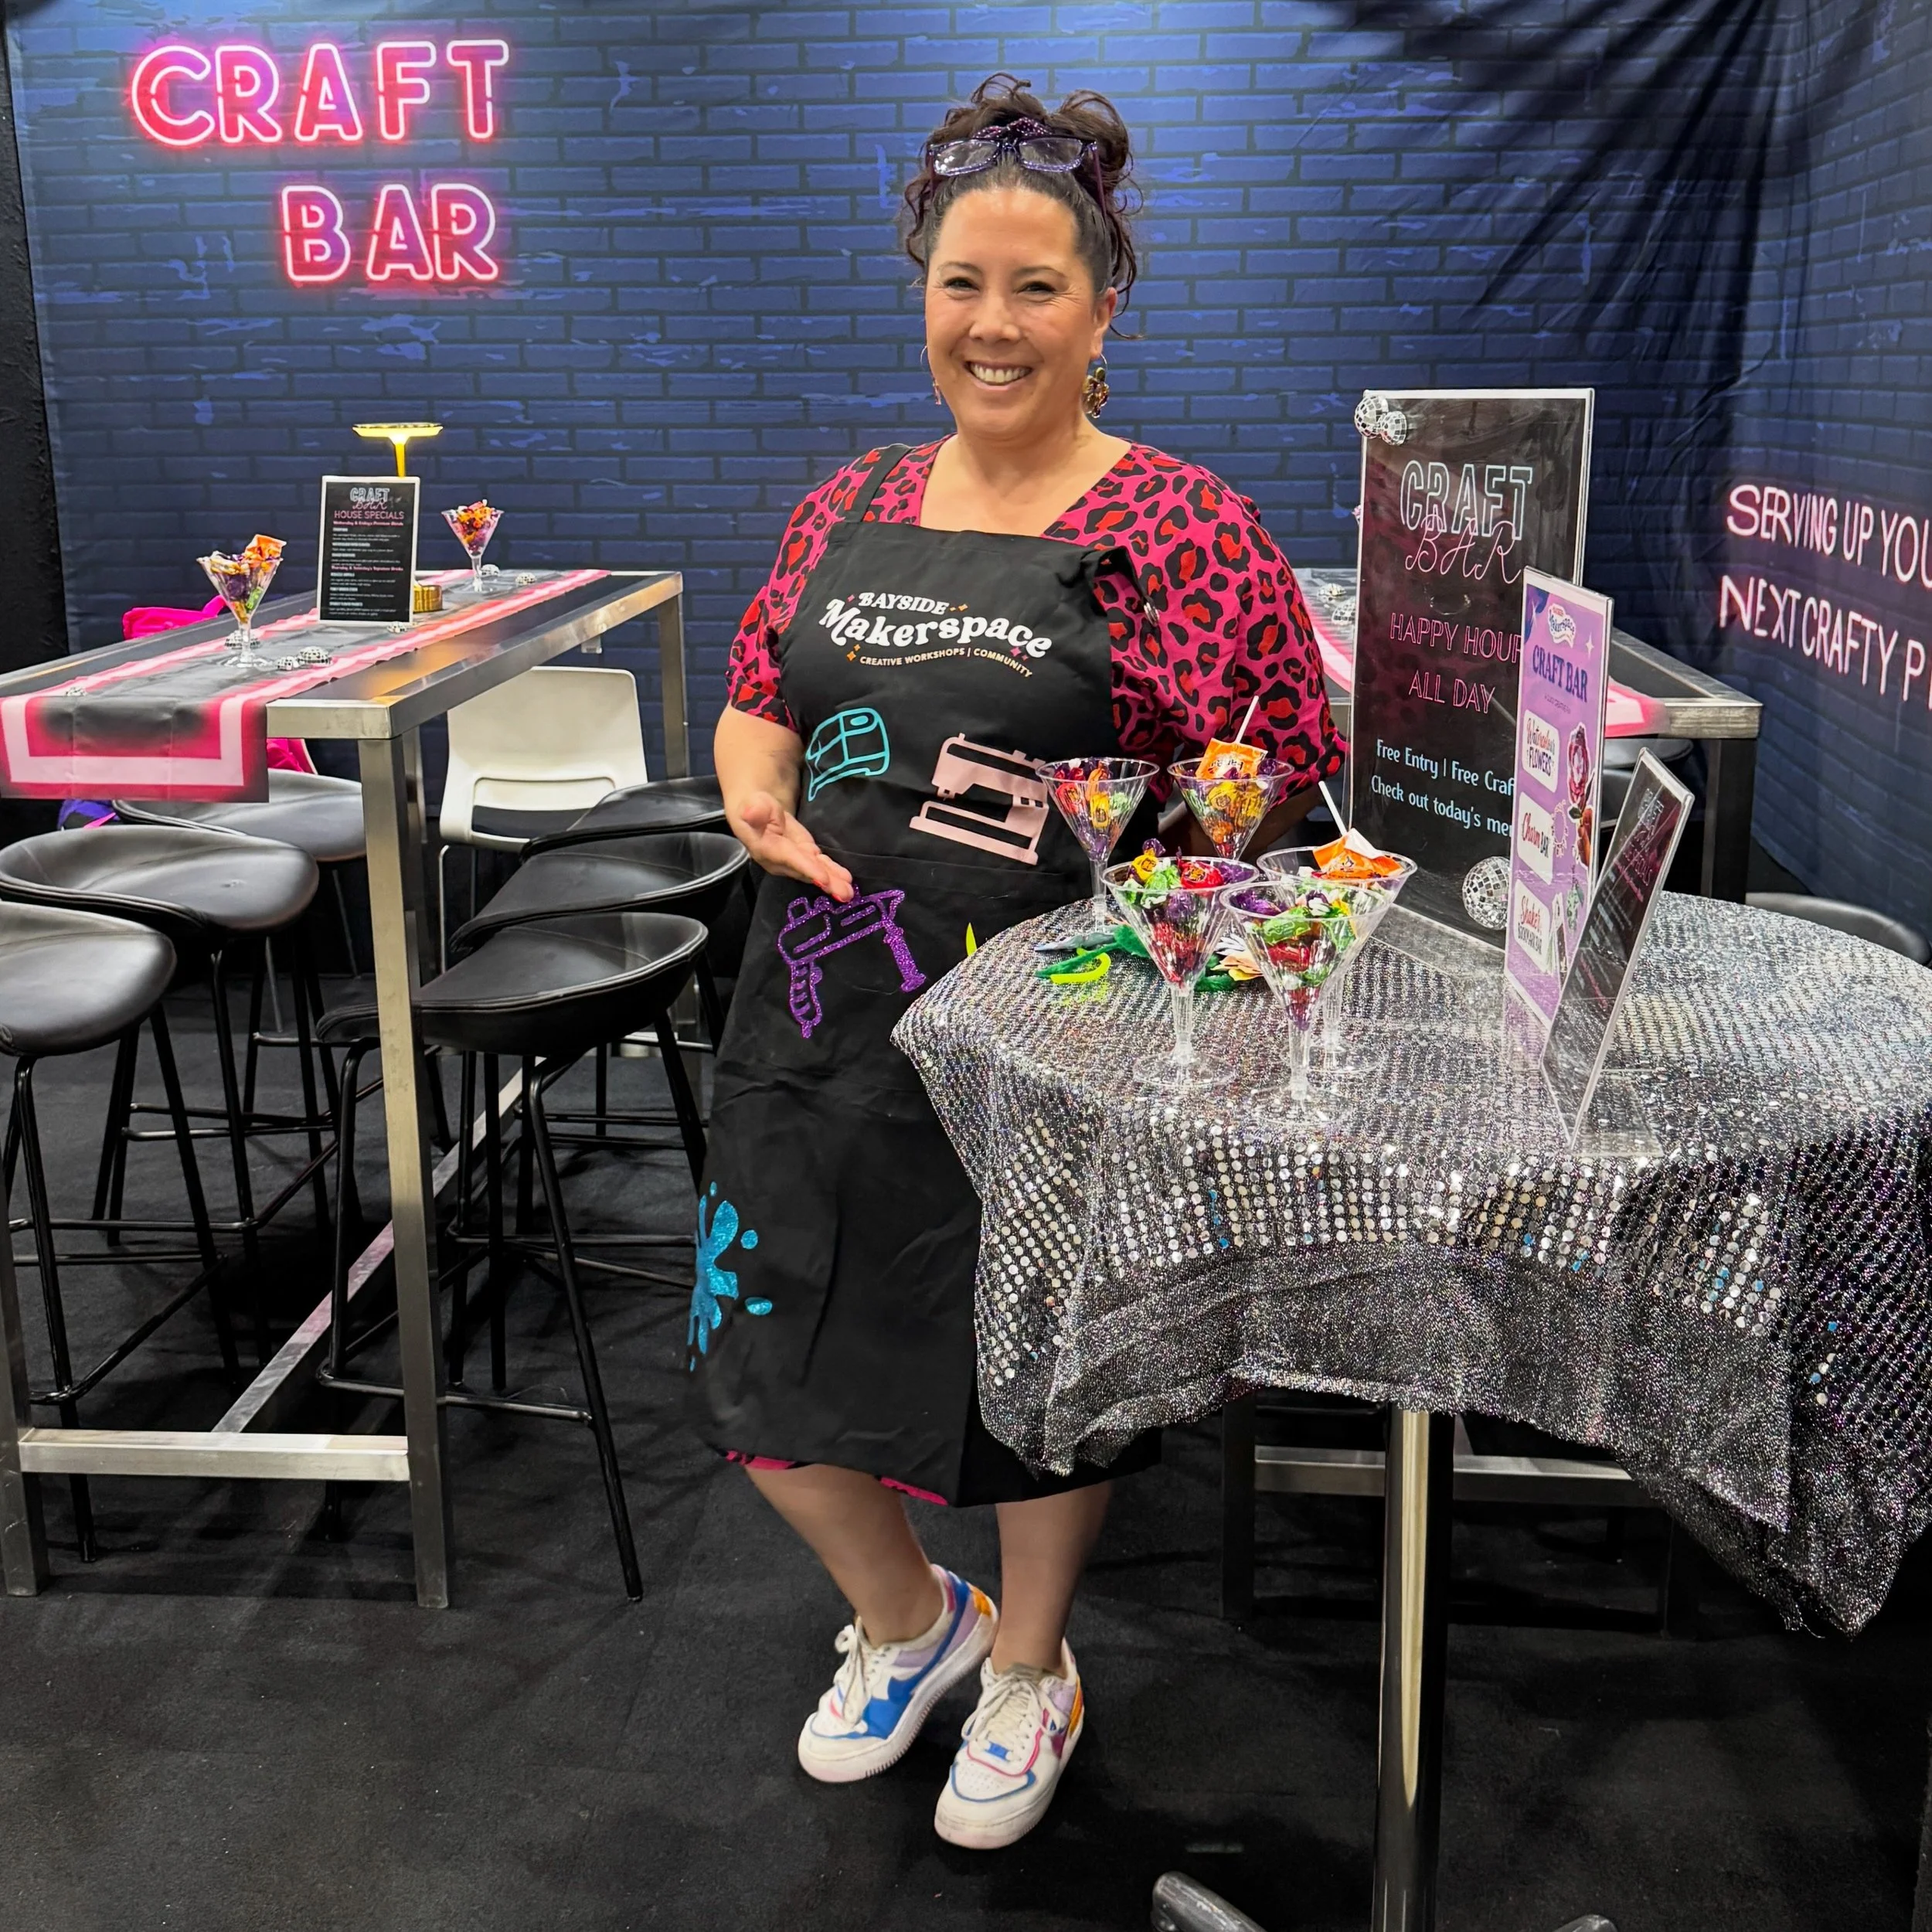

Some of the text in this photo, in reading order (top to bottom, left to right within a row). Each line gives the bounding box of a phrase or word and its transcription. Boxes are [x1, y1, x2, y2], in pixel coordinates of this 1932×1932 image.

[131, 39, 510, 146] CRAFT
[281, 184, 498, 282] BAR
[334, 510, 405, 520] HOUSE SPECIALS
[349, 487, 390, 502] CRAFT
[352, 498, 388, 510] BAR
[1400, 460, 1532, 541] CRAFT
[1405, 513, 1522, 584] BAR
[1726, 484, 1838, 556] SERVING
[1843, 501, 1874, 566] UP
[858, 592, 950, 615] BAYSIDE
[818, 599, 1052, 658] Makerspace
[1390, 612, 1459, 651] HAPPY
[1719, 574, 1932, 711] NEXT CRAFTY P
[859, 656, 903, 666] CREATIVE
[905, 648, 965, 665] WORKSHOPS
[974, 648, 1033, 678] COMMUNITY
[1532, 645, 1588, 702] CRAFT BAR
[1409, 669, 1495, 713] ALL DAY
[1377, 739, 1400, 763] Free
[1405, 747, 1438, 779] Entry
[1451, 760, 1479, 786] Free
[1529, 747, 1551, 776] FLOWERS
[1371, 775, 1404, 801] Check
[1409, 792, 1429, 811] out
[1434, 798, 1481, 829] today's
[1522, 812, 1549, 858] Charm BAR
